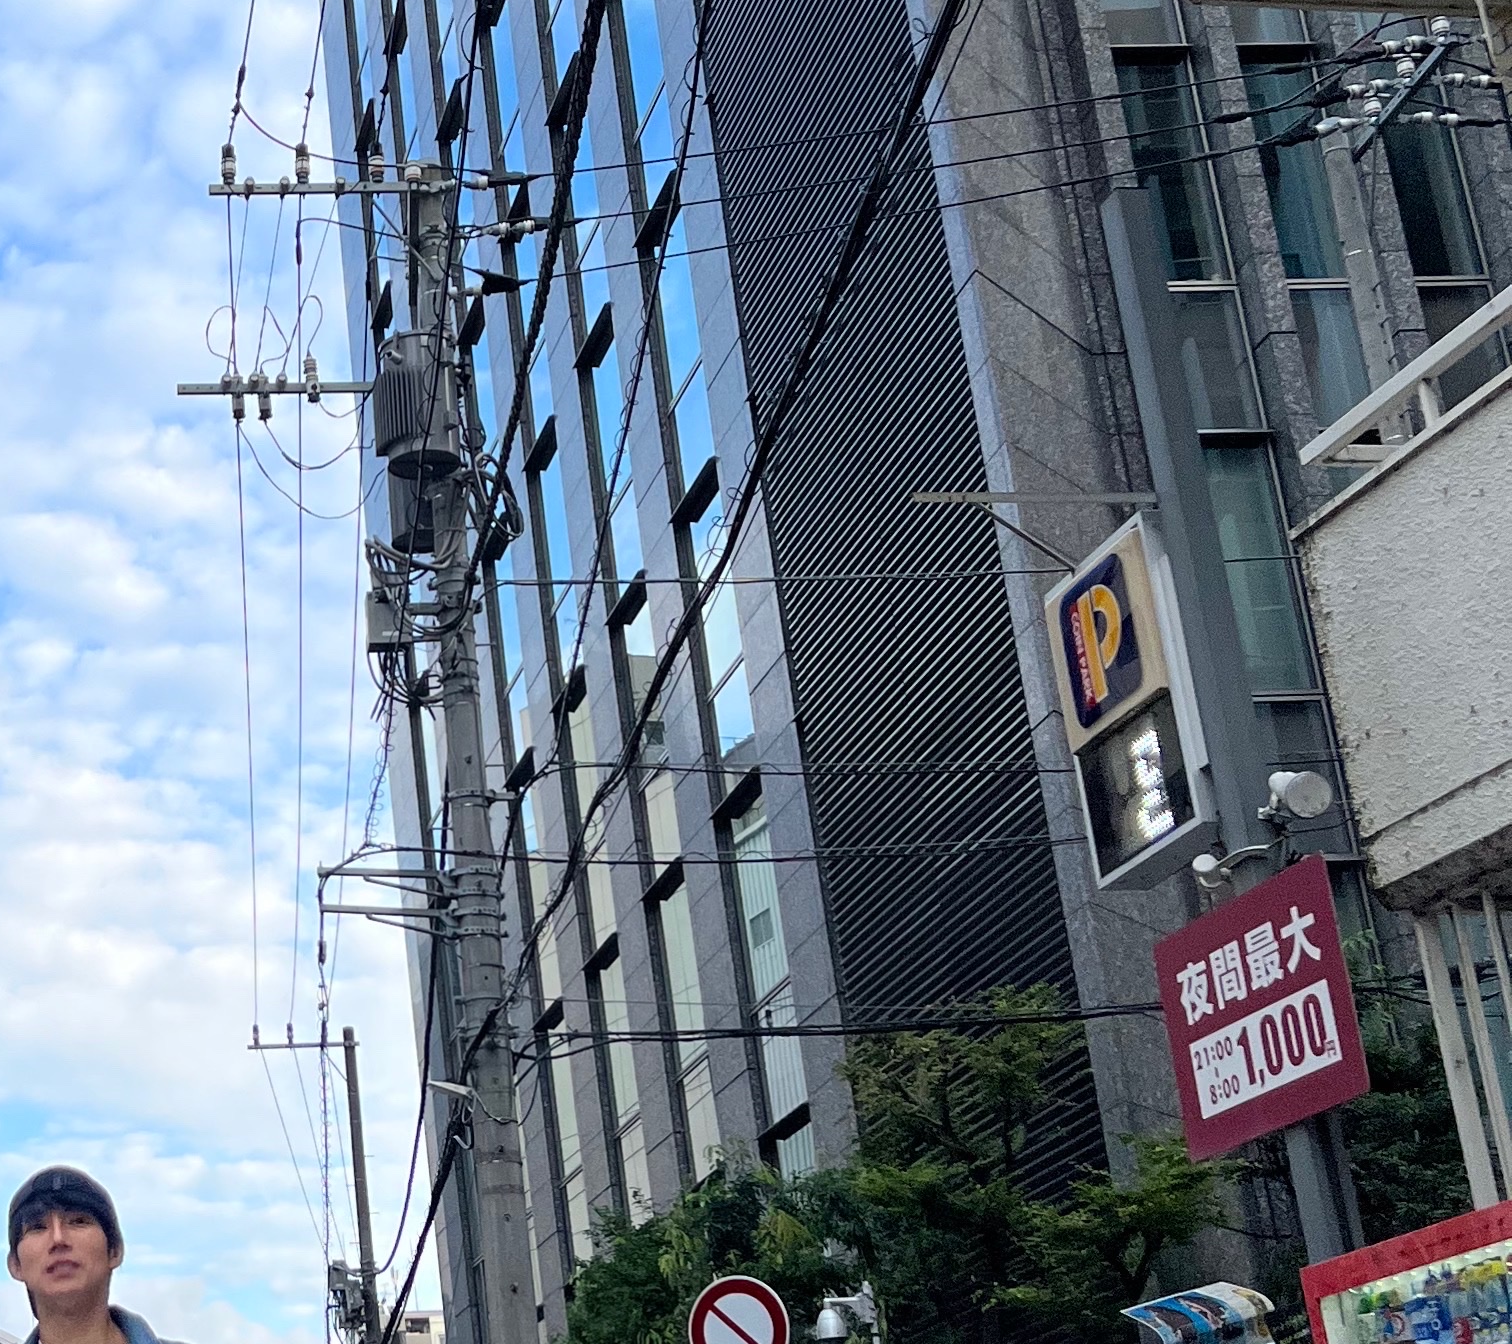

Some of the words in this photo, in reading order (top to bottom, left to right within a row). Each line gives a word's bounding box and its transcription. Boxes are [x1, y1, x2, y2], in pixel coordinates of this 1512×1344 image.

[1076, 583, 1123, 704] P
[1176, 906, 1322, 1026] 夜間最大
[1193, 1035, 1233, 1071] 21:00
[1208, 1074, 1240, 1105] 8:00
